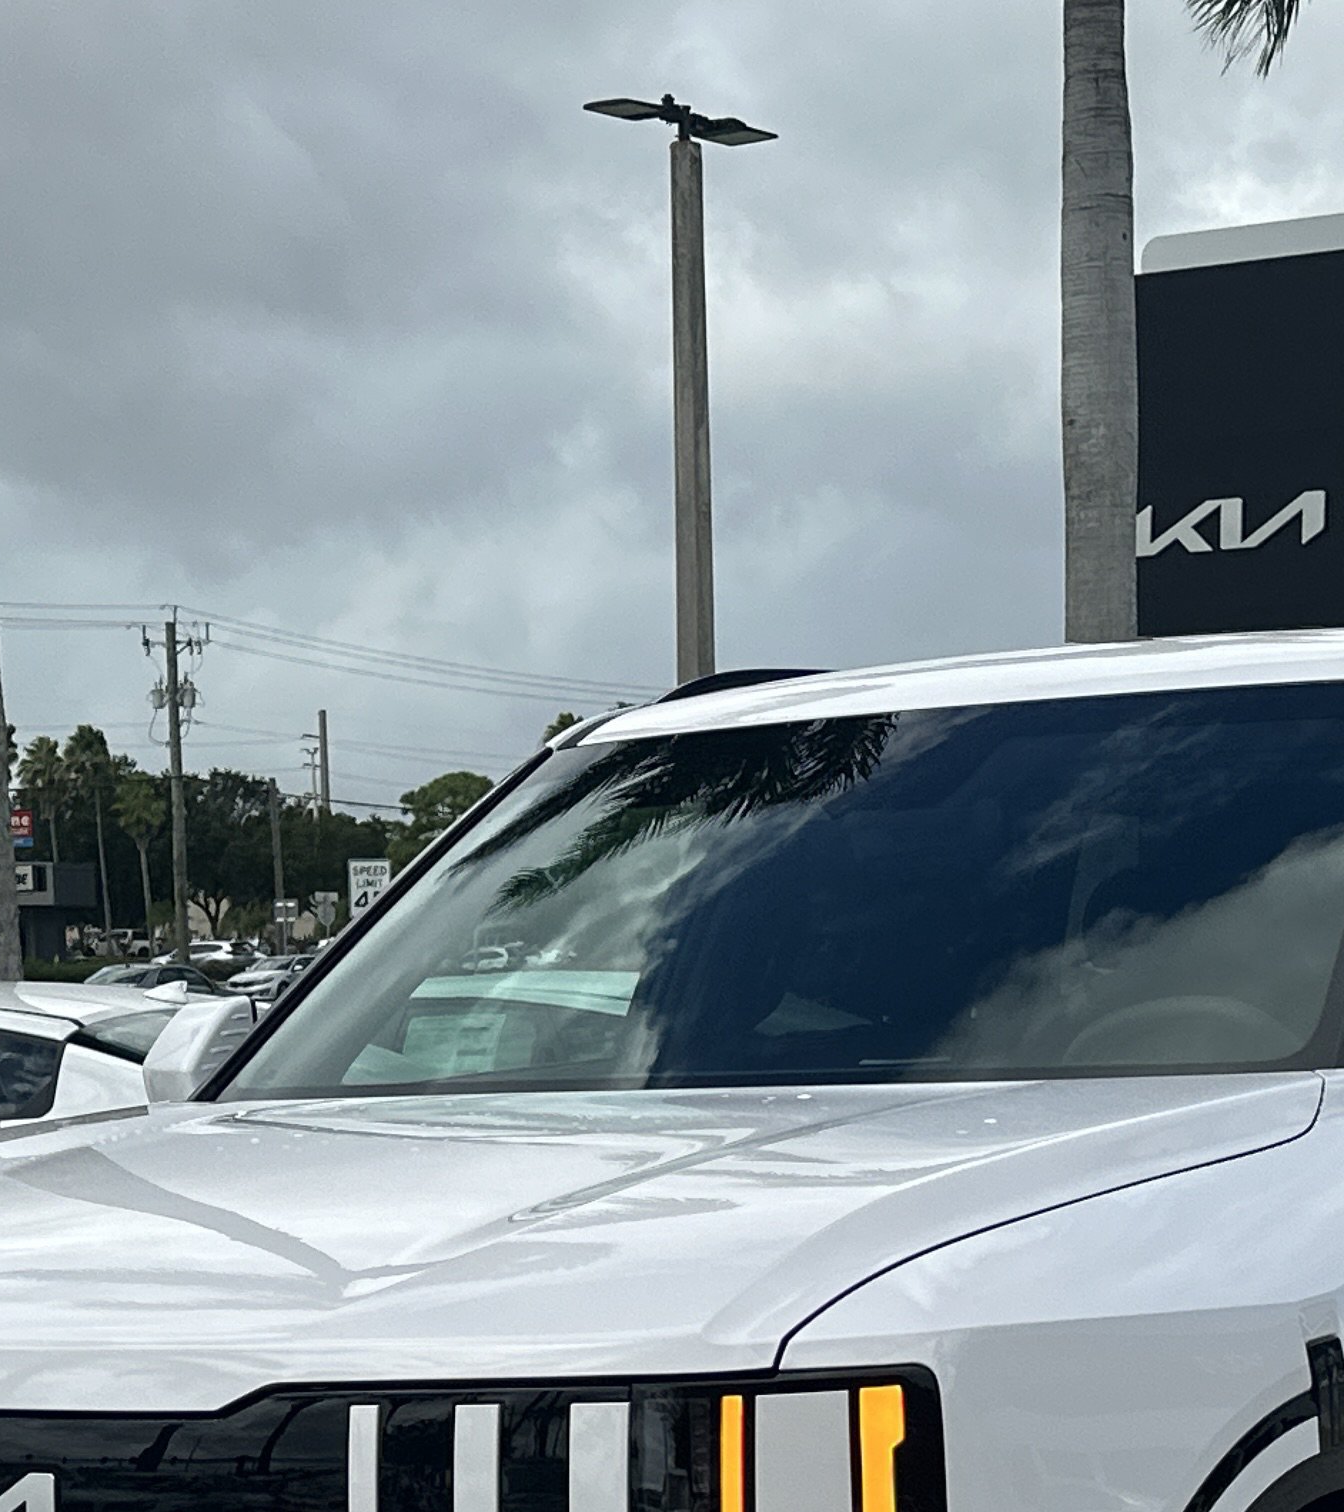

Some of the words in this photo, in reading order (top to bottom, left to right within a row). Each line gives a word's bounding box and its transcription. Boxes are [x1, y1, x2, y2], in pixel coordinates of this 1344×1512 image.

[1135, 489, 1327, 558] KIA
[351, 865, 388, 877] SPEED
[356, 878, 383, 889] LIMIT
